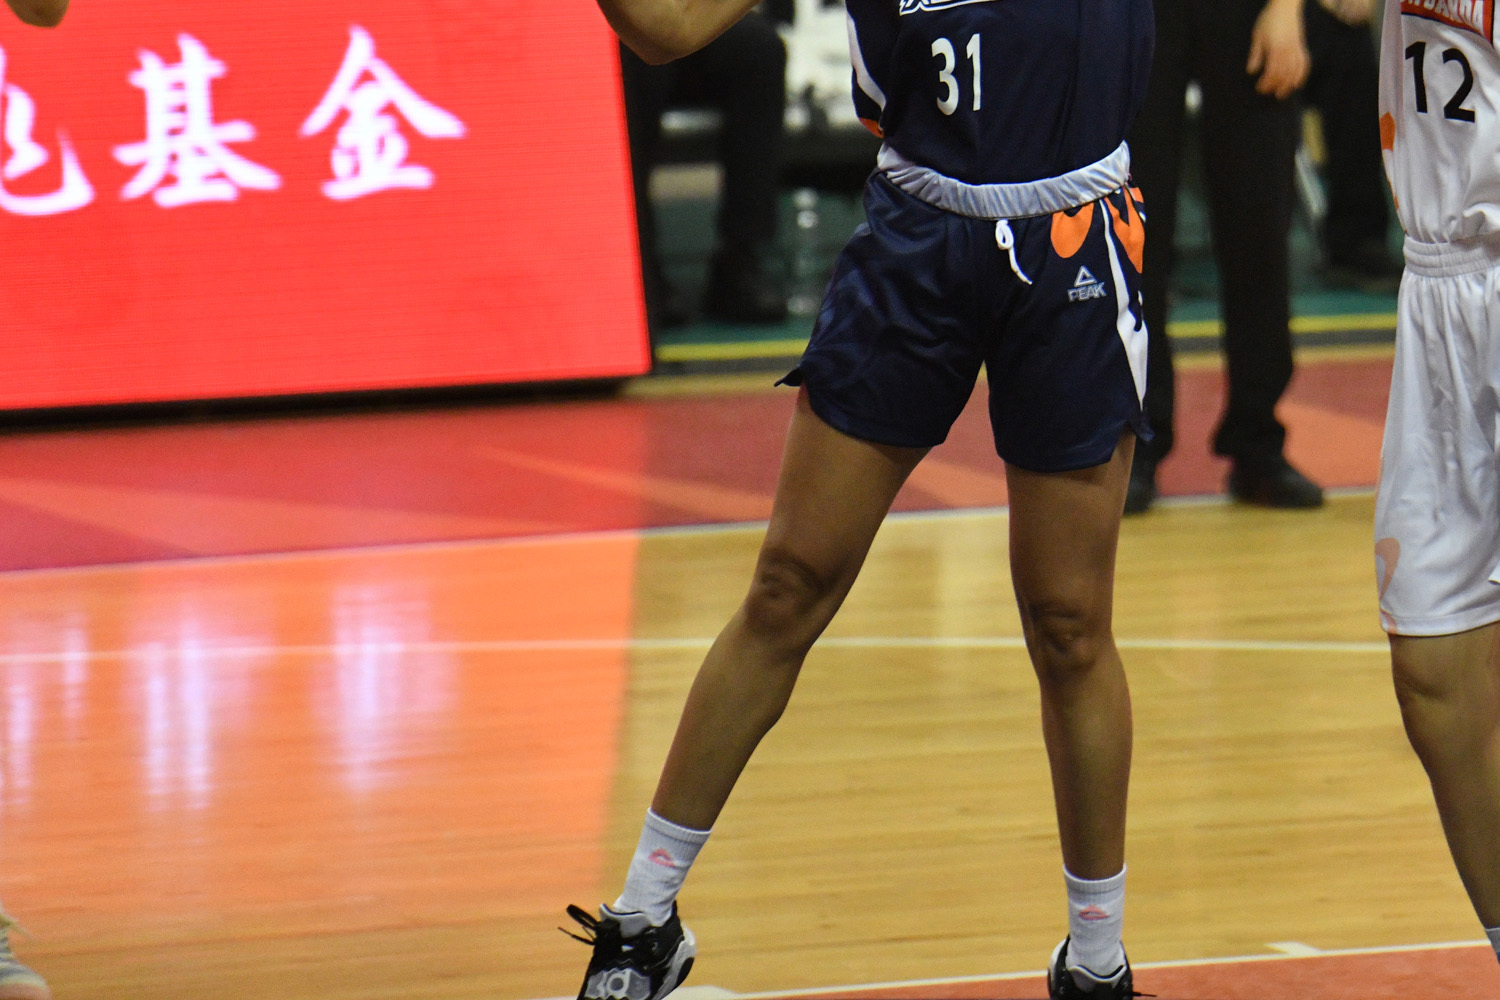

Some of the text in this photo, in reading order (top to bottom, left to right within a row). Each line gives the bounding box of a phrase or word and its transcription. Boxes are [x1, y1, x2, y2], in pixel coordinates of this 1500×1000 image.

[931, 33, 982, 115] 31
[1405, 41, 1476, 123] 12
[1068, 281, 1107, 303] PEAK
